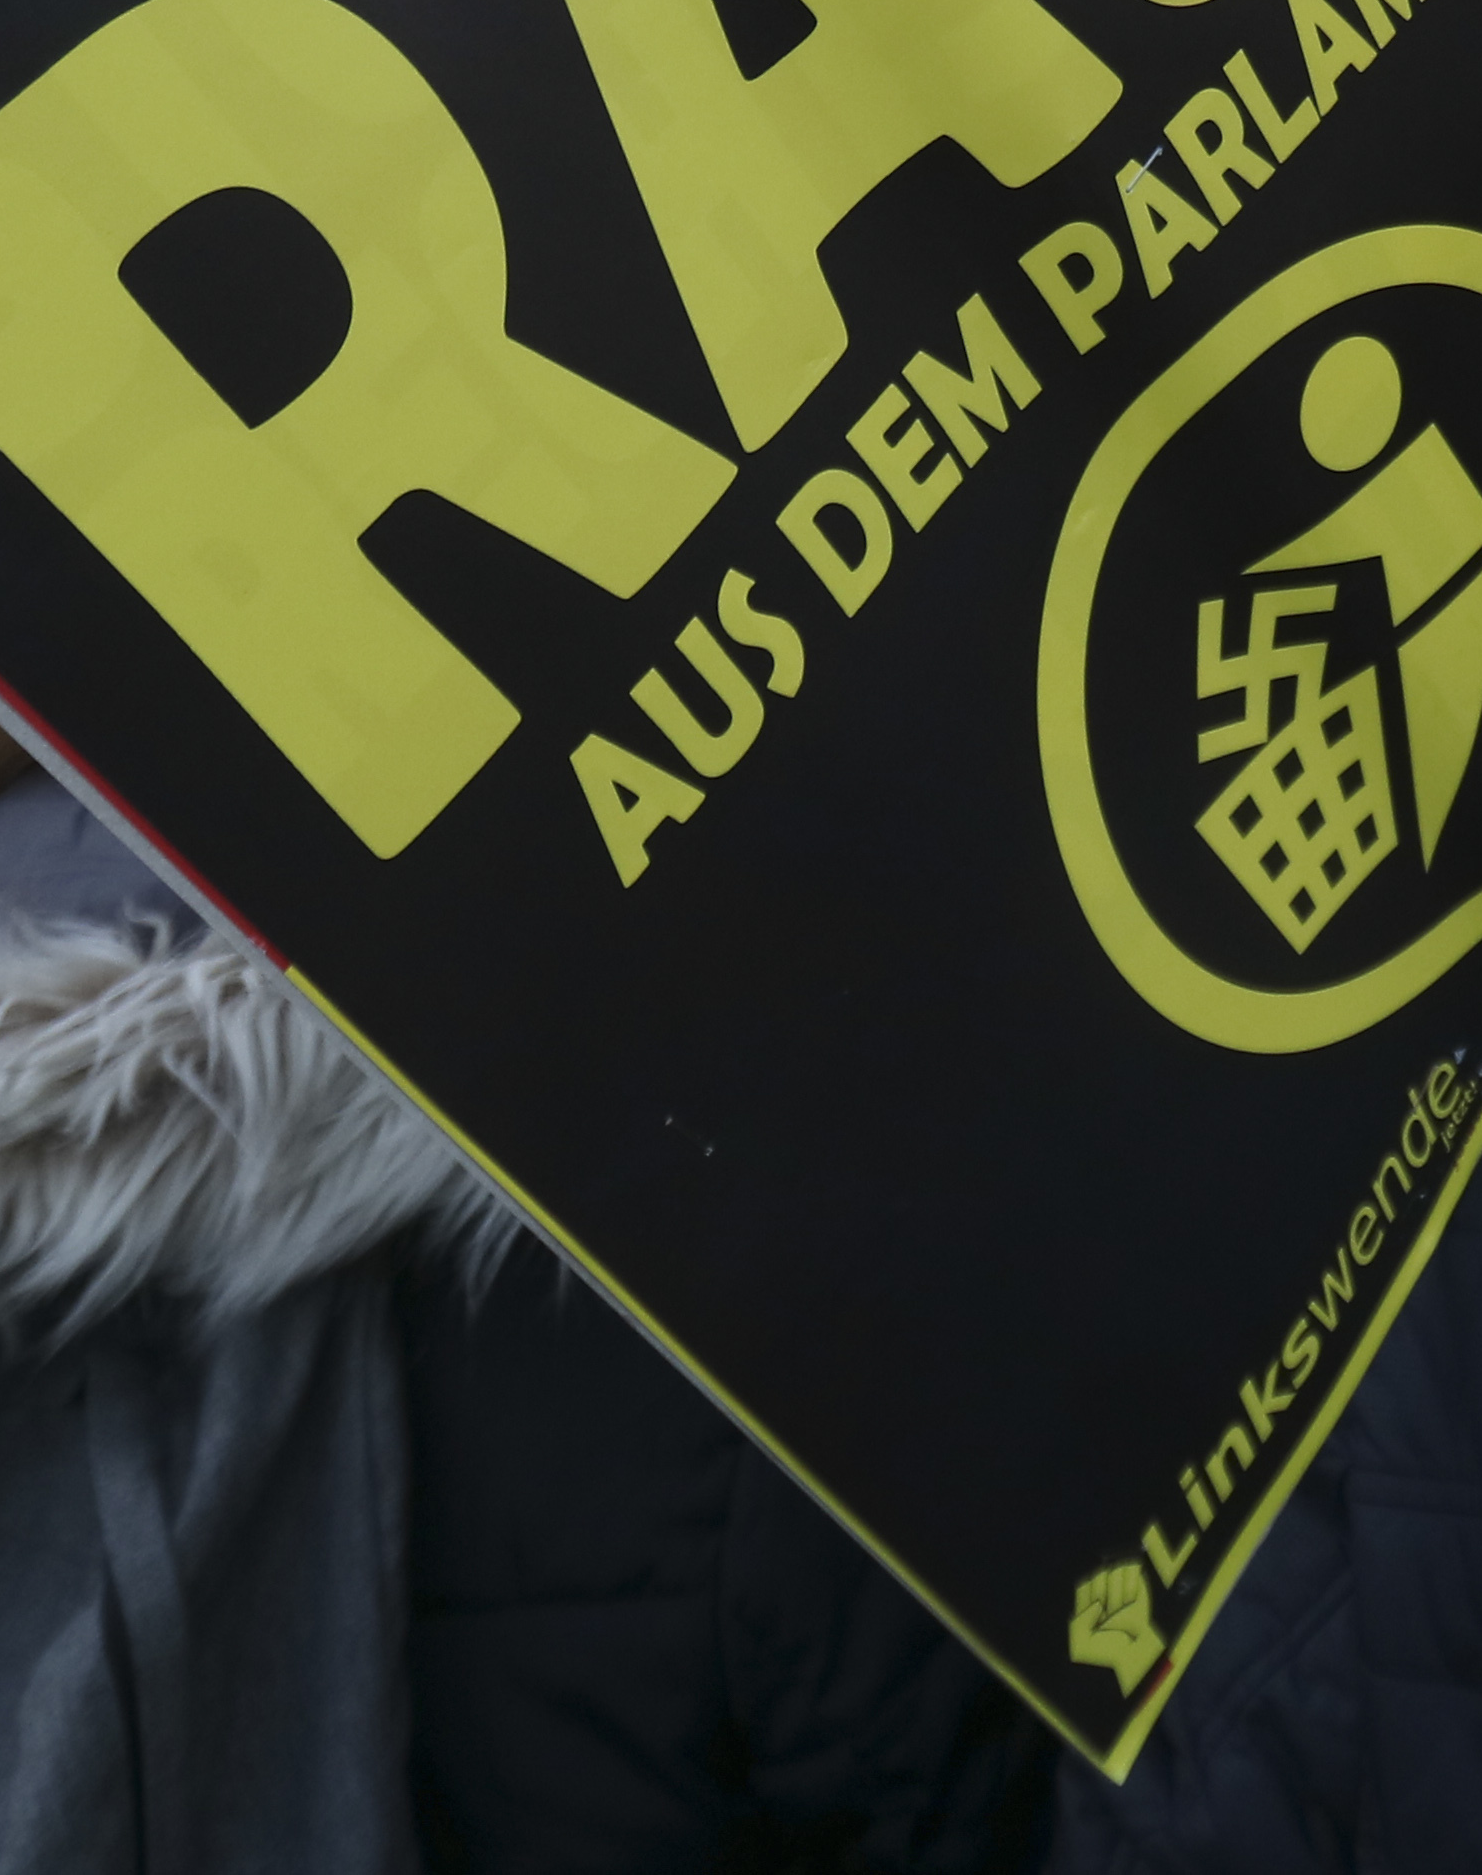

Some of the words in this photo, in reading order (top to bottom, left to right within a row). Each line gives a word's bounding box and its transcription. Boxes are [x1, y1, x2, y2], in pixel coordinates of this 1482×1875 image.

[569, 567, 804, 889] AUS
[776, 291, 1043, 619] DEM
[1140, 1060, 1459, 1590] Linkswende
[1440, 1079, 1478, 1154] jetzt!
